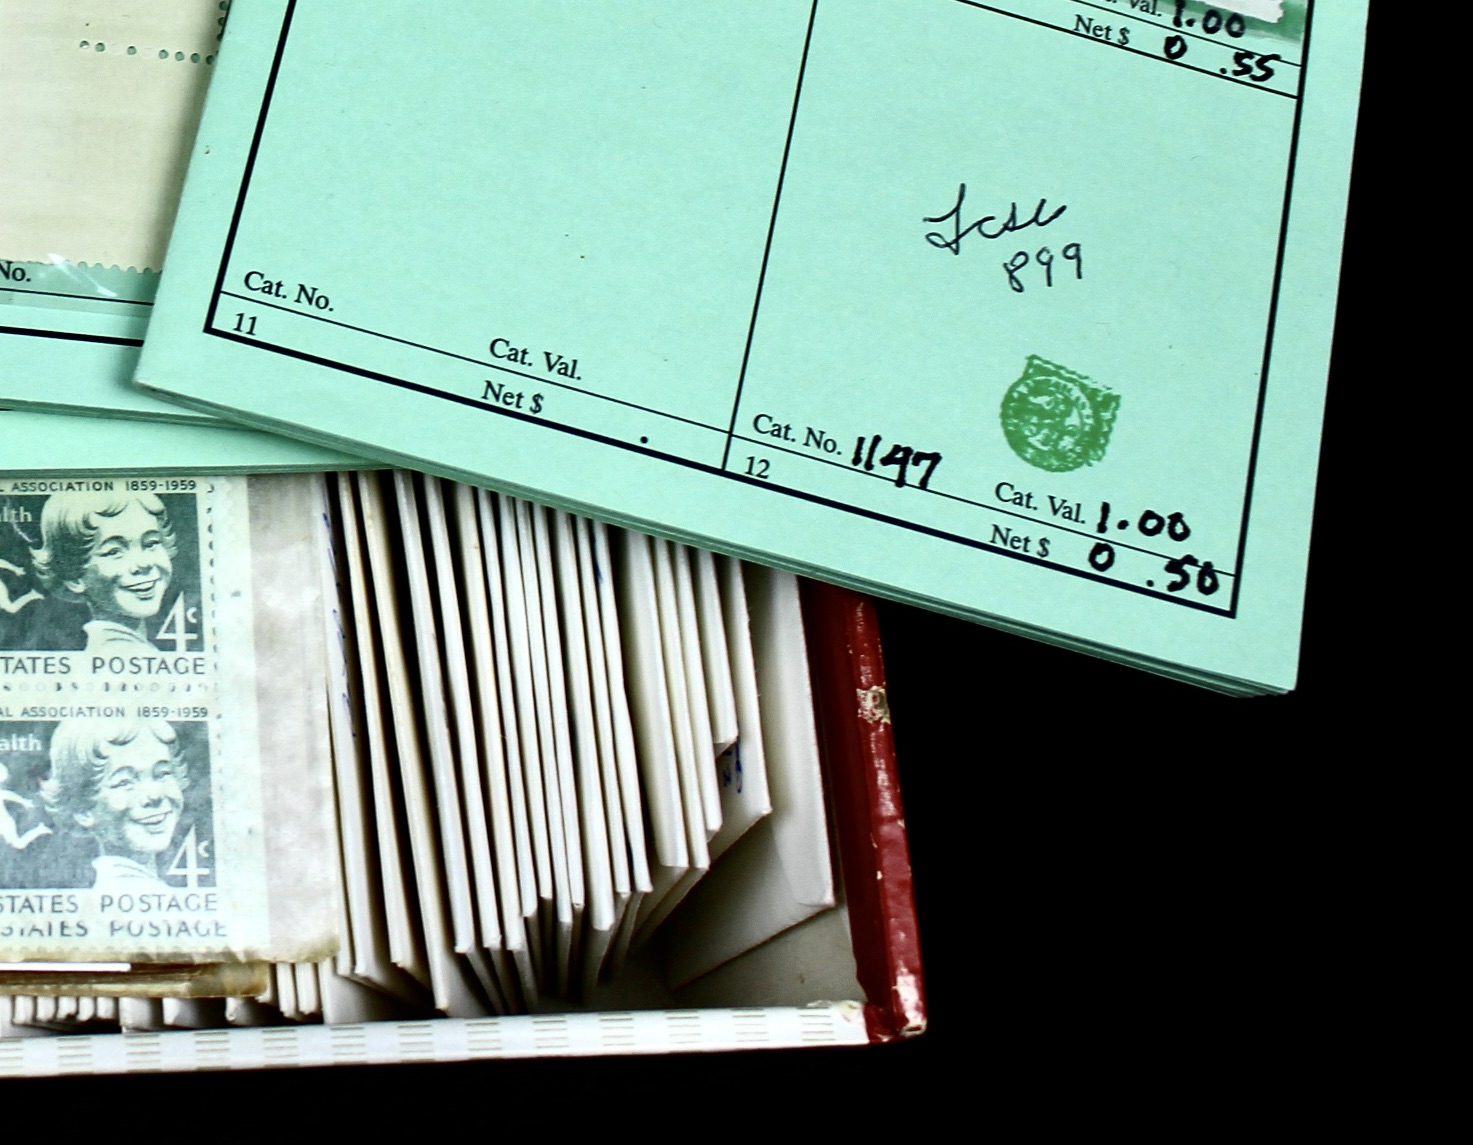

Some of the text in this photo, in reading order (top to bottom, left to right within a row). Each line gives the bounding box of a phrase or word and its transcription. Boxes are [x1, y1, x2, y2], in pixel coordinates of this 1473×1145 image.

[1074, 14, 1131, 46] Net $
[1002, 242, 1084, 293] 899
[244, 271, 334, 311] Cat. No.
[233, 313, 257, 335] 11
[752, 413, 842, 456] Cat. No.
[744, 456, 770, 480] 12
[851, 435, 942, 489] 1147
[12, 481, 115, 492] ASSOCIATION
[125, 480, 197, 491] 1859-1959
[994, 482, 1087, 525] Cat. Val.
[989, 524, 1052, 559] Net $
[92, 656, 206, 675] POSTAGE
[100, 894, 218, 914] POSTAGE
